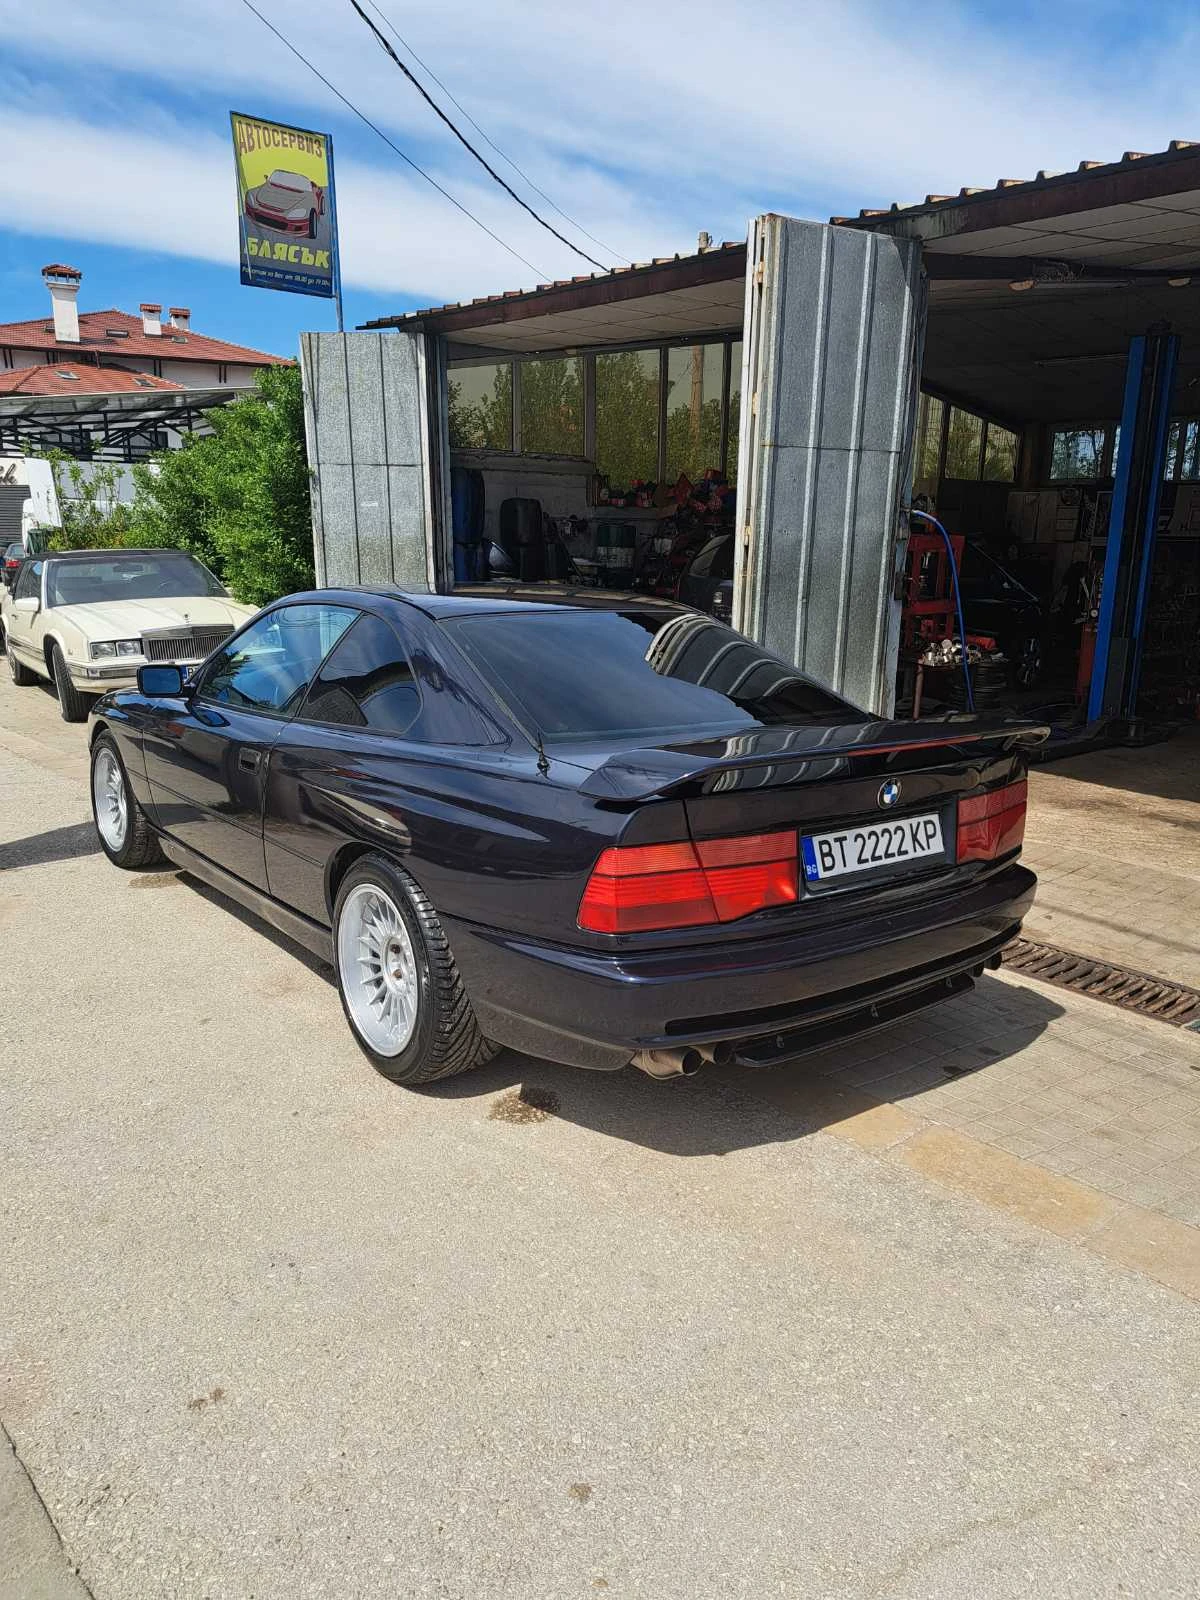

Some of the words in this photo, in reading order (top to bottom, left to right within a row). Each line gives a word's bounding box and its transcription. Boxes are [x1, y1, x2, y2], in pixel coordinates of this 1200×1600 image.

[236, 121, 323, 159] АВТОСЕРВИЗ
[247, 237, 330, 269] БЛЯСЪК
[818, 836, 848, 873] BT
[853, 825, 909, 865] 2222
[909, 819, 937, 853] KP
[806, 864, 818, 875] BG
